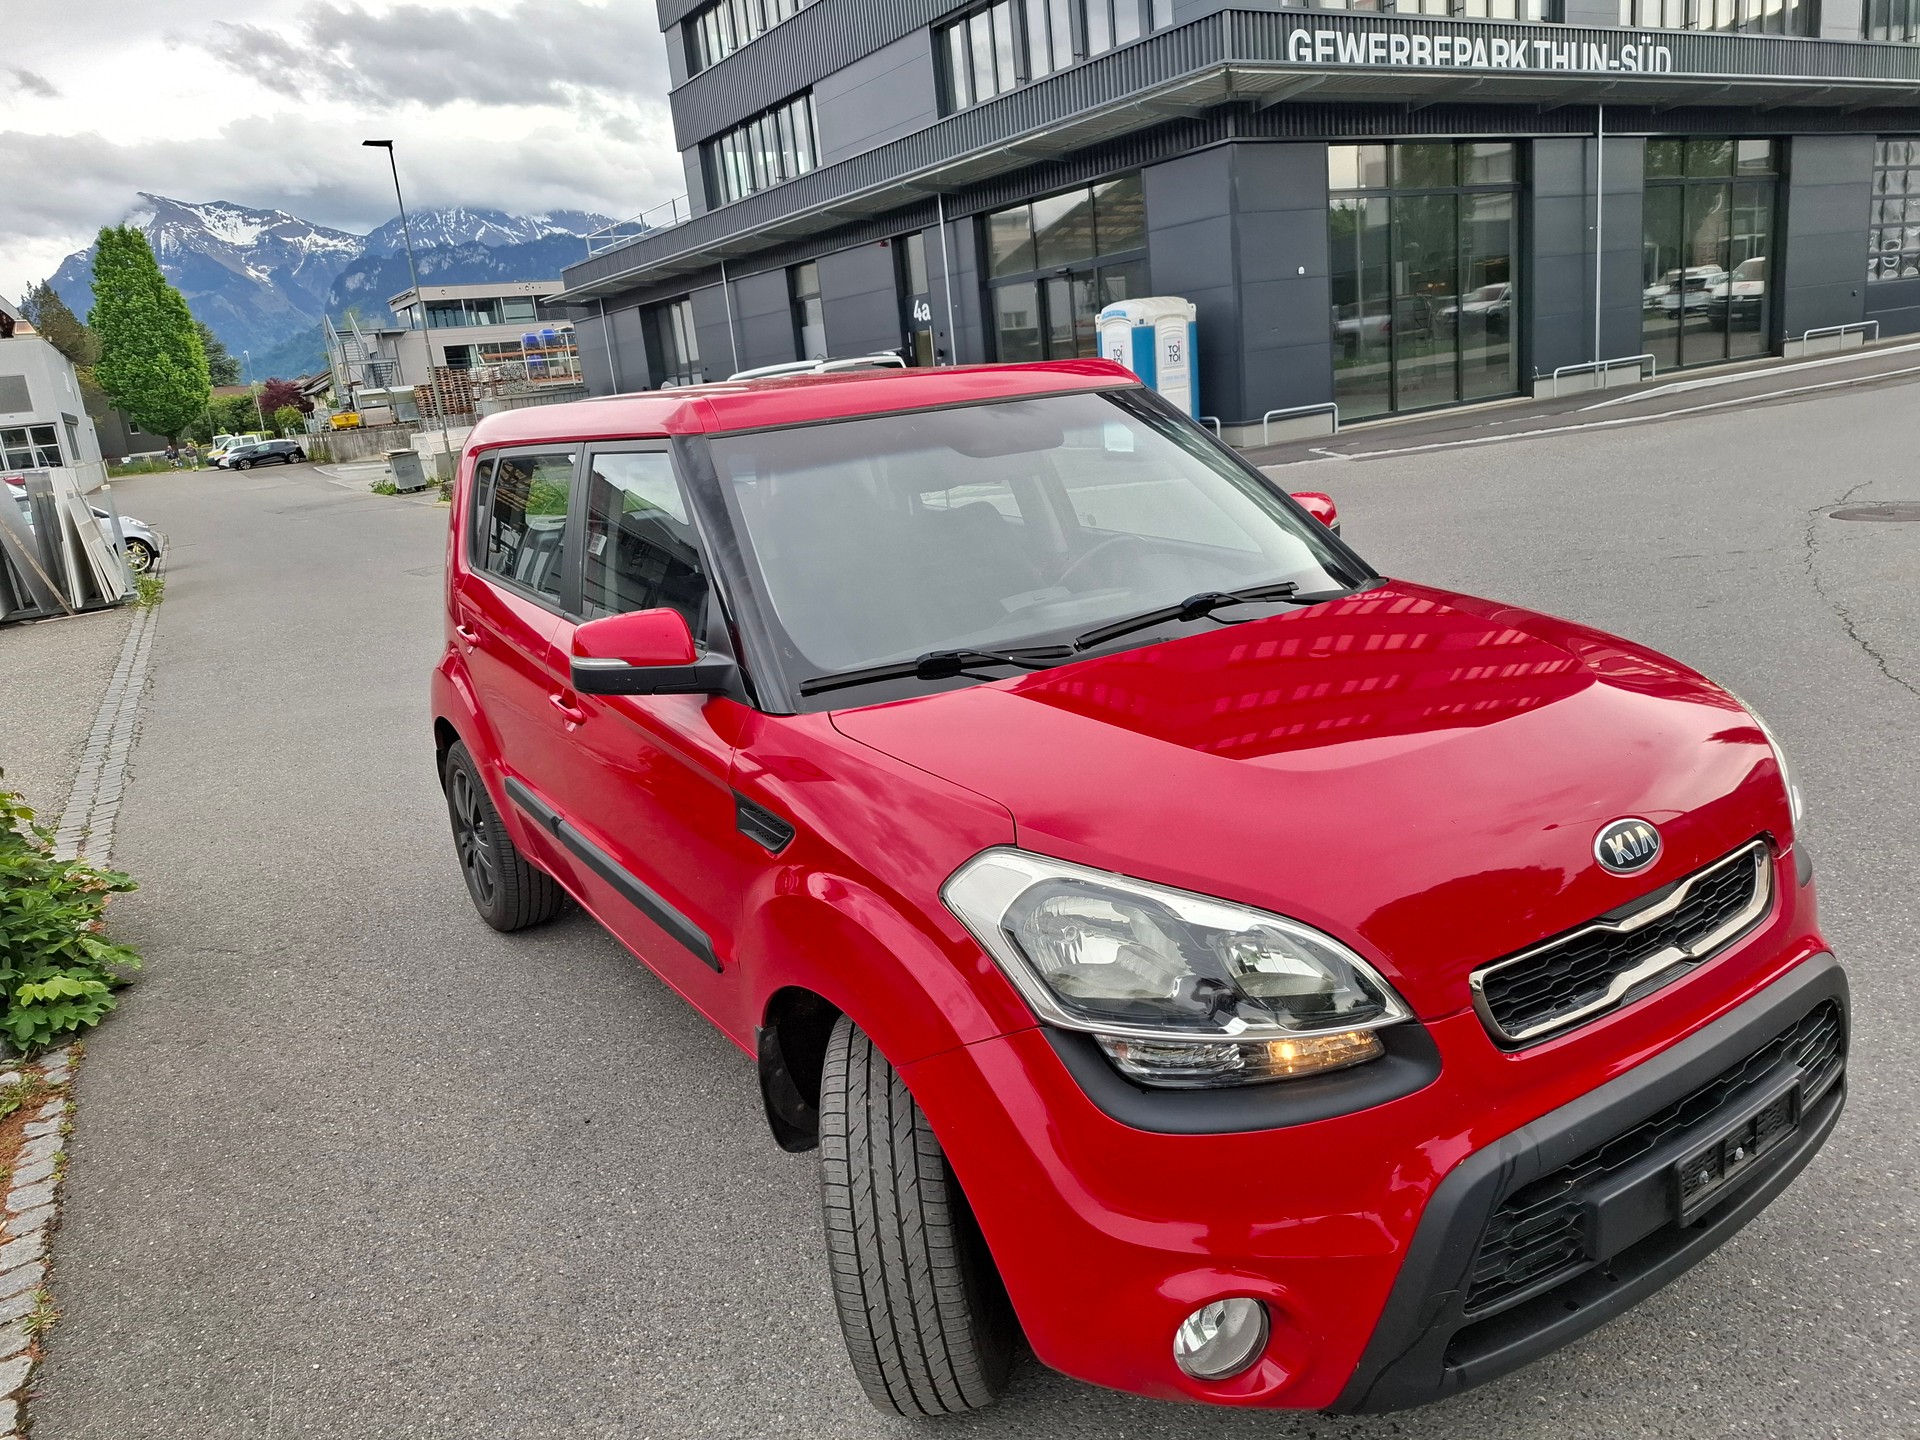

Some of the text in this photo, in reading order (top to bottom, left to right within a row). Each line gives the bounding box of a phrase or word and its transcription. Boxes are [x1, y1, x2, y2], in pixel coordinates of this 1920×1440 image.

[1288, 28, 1671, 73] GEWERBEPARK THUN-SÜD
[913, 299, 931, 322] 4a
[1168, 353, 1181, 363] TOI
[1604, 825, 1657, 865] KIA
